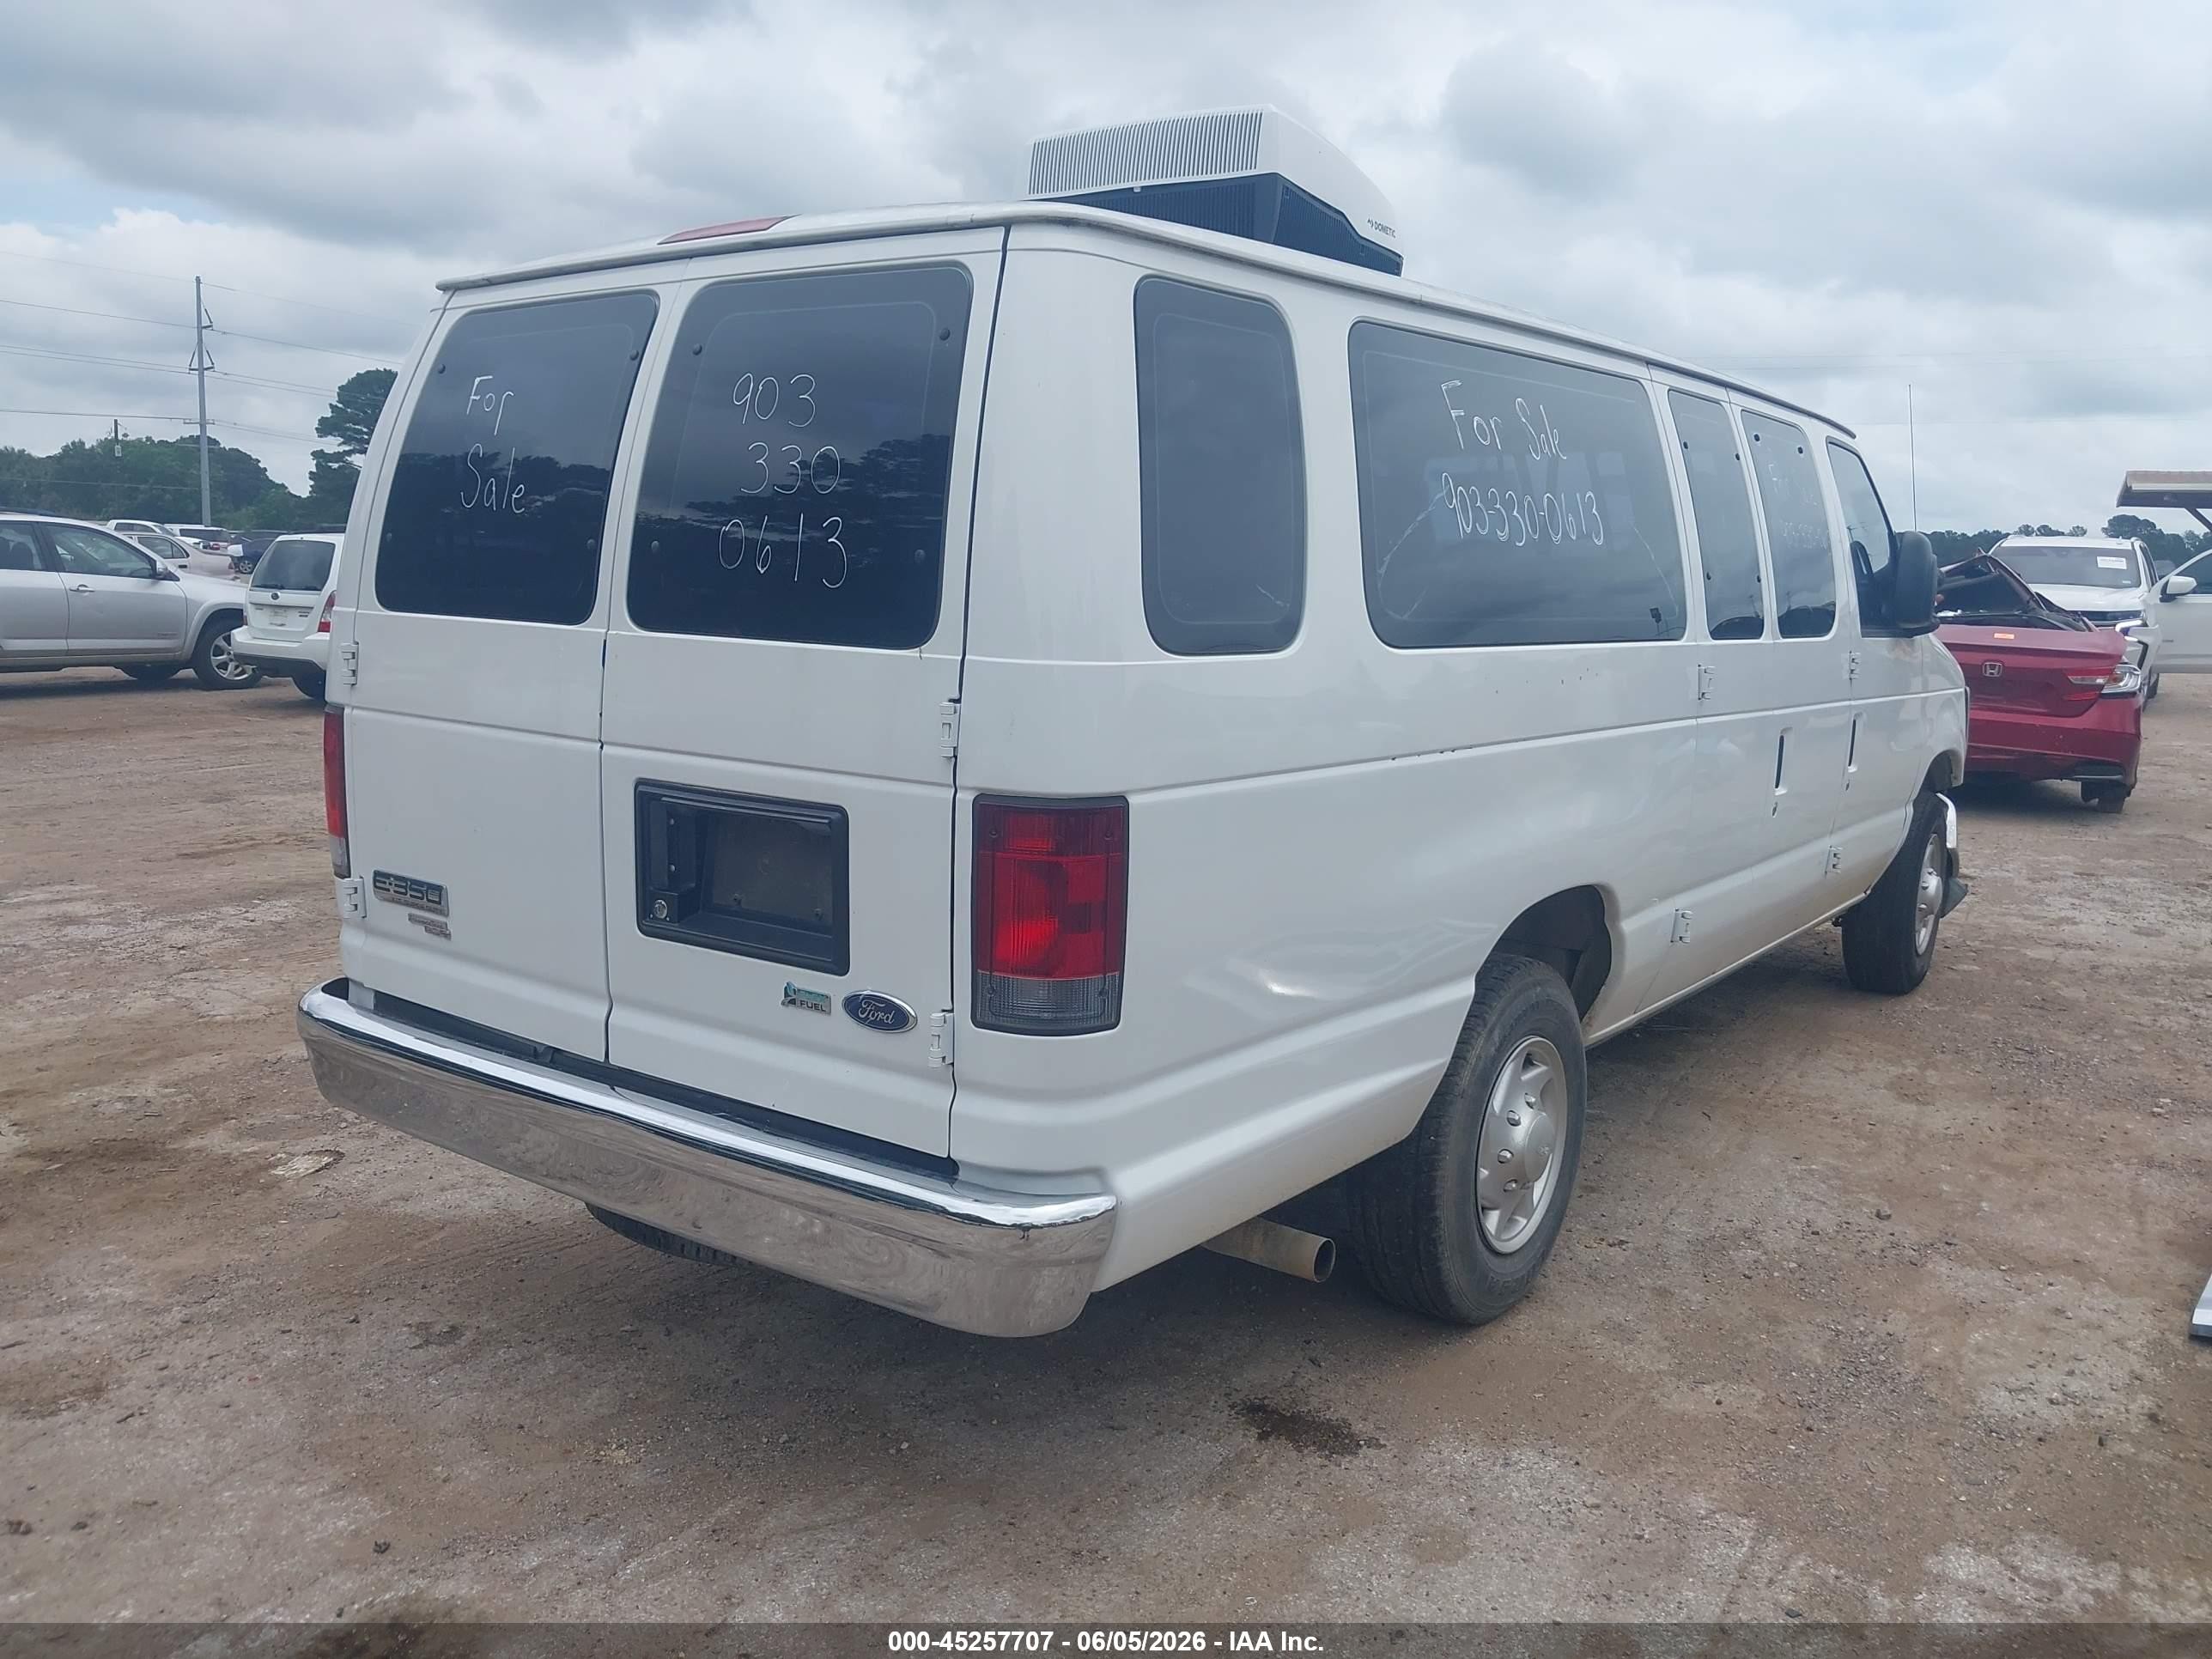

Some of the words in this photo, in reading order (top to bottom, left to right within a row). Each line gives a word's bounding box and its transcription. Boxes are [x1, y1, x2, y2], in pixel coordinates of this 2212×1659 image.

[466, 375, 514, 436] For
[732, 372, 817, 428] 903
[1440, 380, 1504, 451] For
[1515, 397, 1567, 461] Sale
[459, 443, 526, 514] Sale
[739, 441, 842, 495] 330
[1441, 472, 1605, 548] 903-330-0613
[718, 512, 848, 589] 0613
[799, 1000, 827, 1012] FUEL
[858, 997, 896, 1026] Ford
